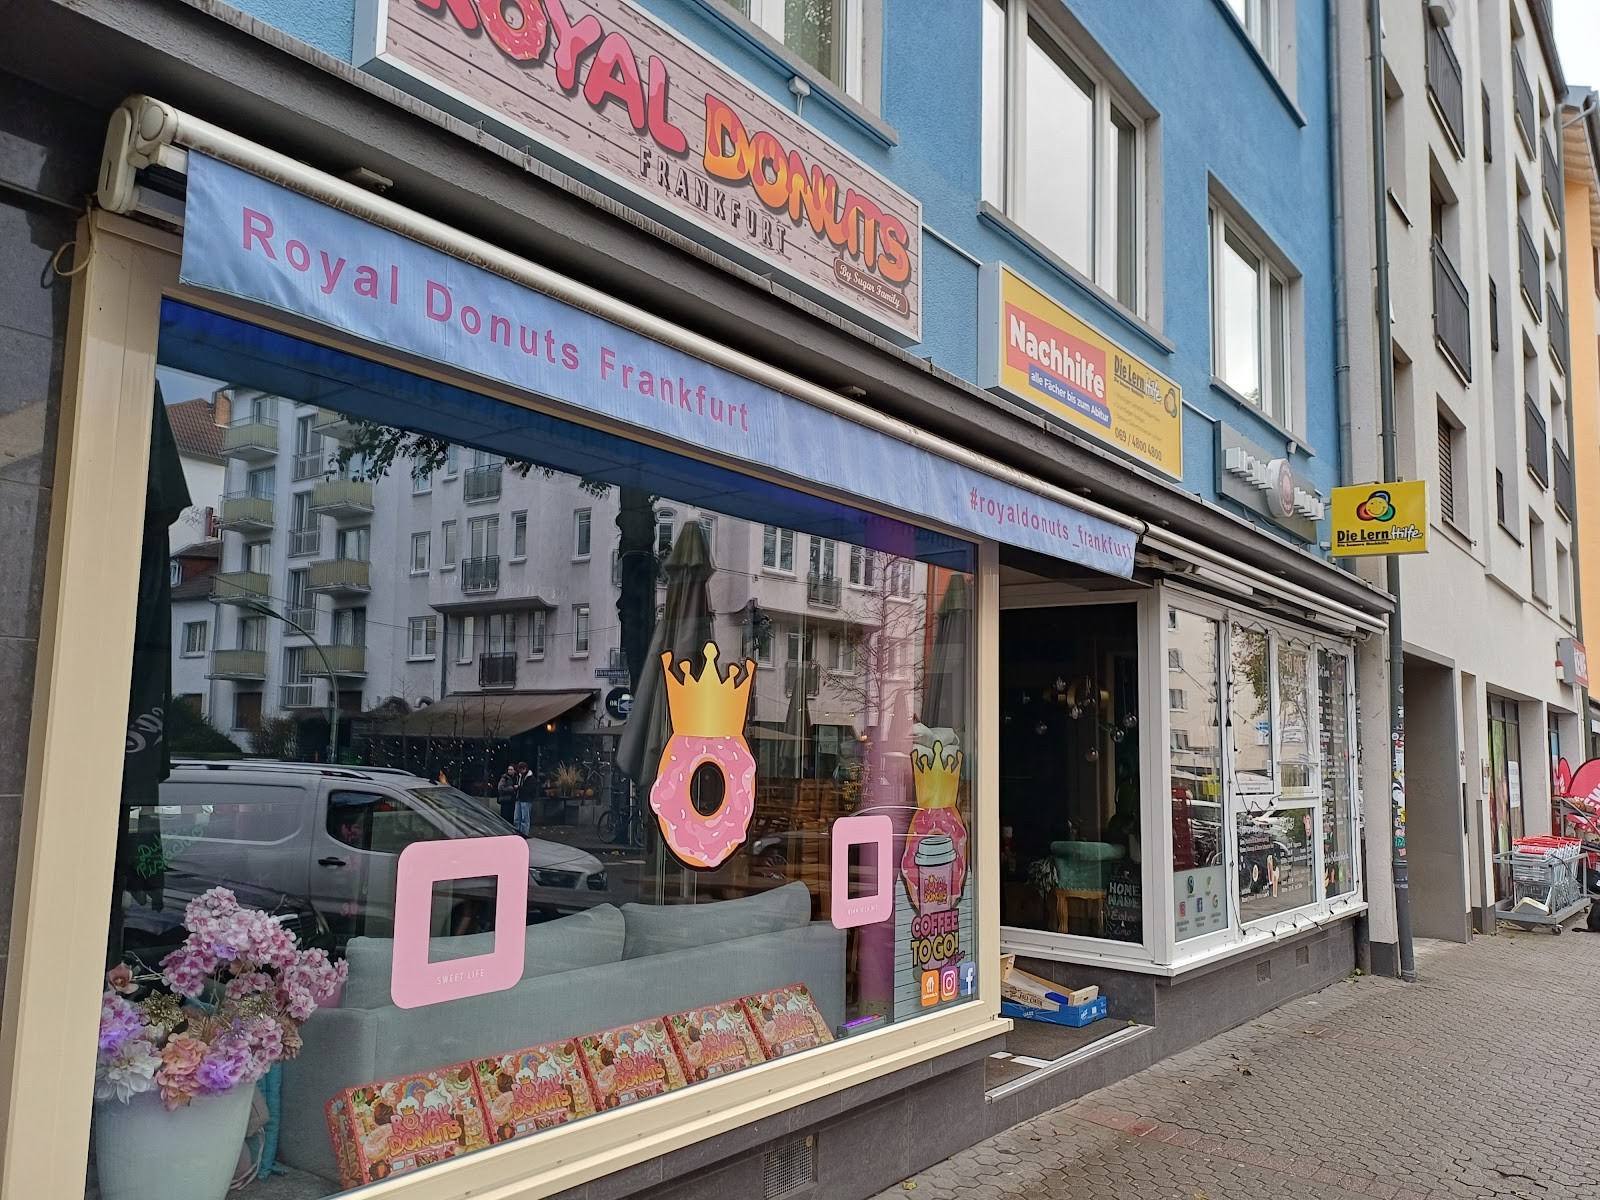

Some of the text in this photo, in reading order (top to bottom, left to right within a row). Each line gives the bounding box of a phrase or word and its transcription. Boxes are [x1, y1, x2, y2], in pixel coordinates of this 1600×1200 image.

[639, 144, 786, 254] FRANKFURT
[703, 92, 911, 282] DONUTS
[840, 264, 901, 309] By Sugar Family
[243, 206, 749, 432] Royal Donuts Frankfurt
[1010, 313, 1104, 399] Nachhilfe
[1114, 354, 1127, 378] Die
[1031, 371, 1043, 386] alle
[1044, 378, 1066, 399] Fächer
[1067, 389, 1076, 405] bis
[1076, 398, 1090, 411] zum
[1091, 405, 1109, 423] Abitur
[1115, 427, 1127, 442] 069
[1132, 434, 1147, 453] 4800
[1148, 443, 1162, 461] 4800
[1337, 530, 1357, 541] Die
[924, 876, 947, 892] ROYAL
[924, 891, 947, 904] DONUTS
[1109, 882, 1140, 896] HOME
[1108, 895, 1140, 908] MADE
[911, 908, 959, 939] COFFEE
[437, 969, 485, 984] SWEET LIFE
[613, 1049, 658, 1074] ROYAL
[613, 1063, 666, 1090] DONUTS
[510, 1074, 565, 1103] ROYAL
[390, 1103, 454, 1135] ROYAL
[510, 1089, 571, 1120] DONUTS
[388, 1119, 462, 1156] DONUTS
